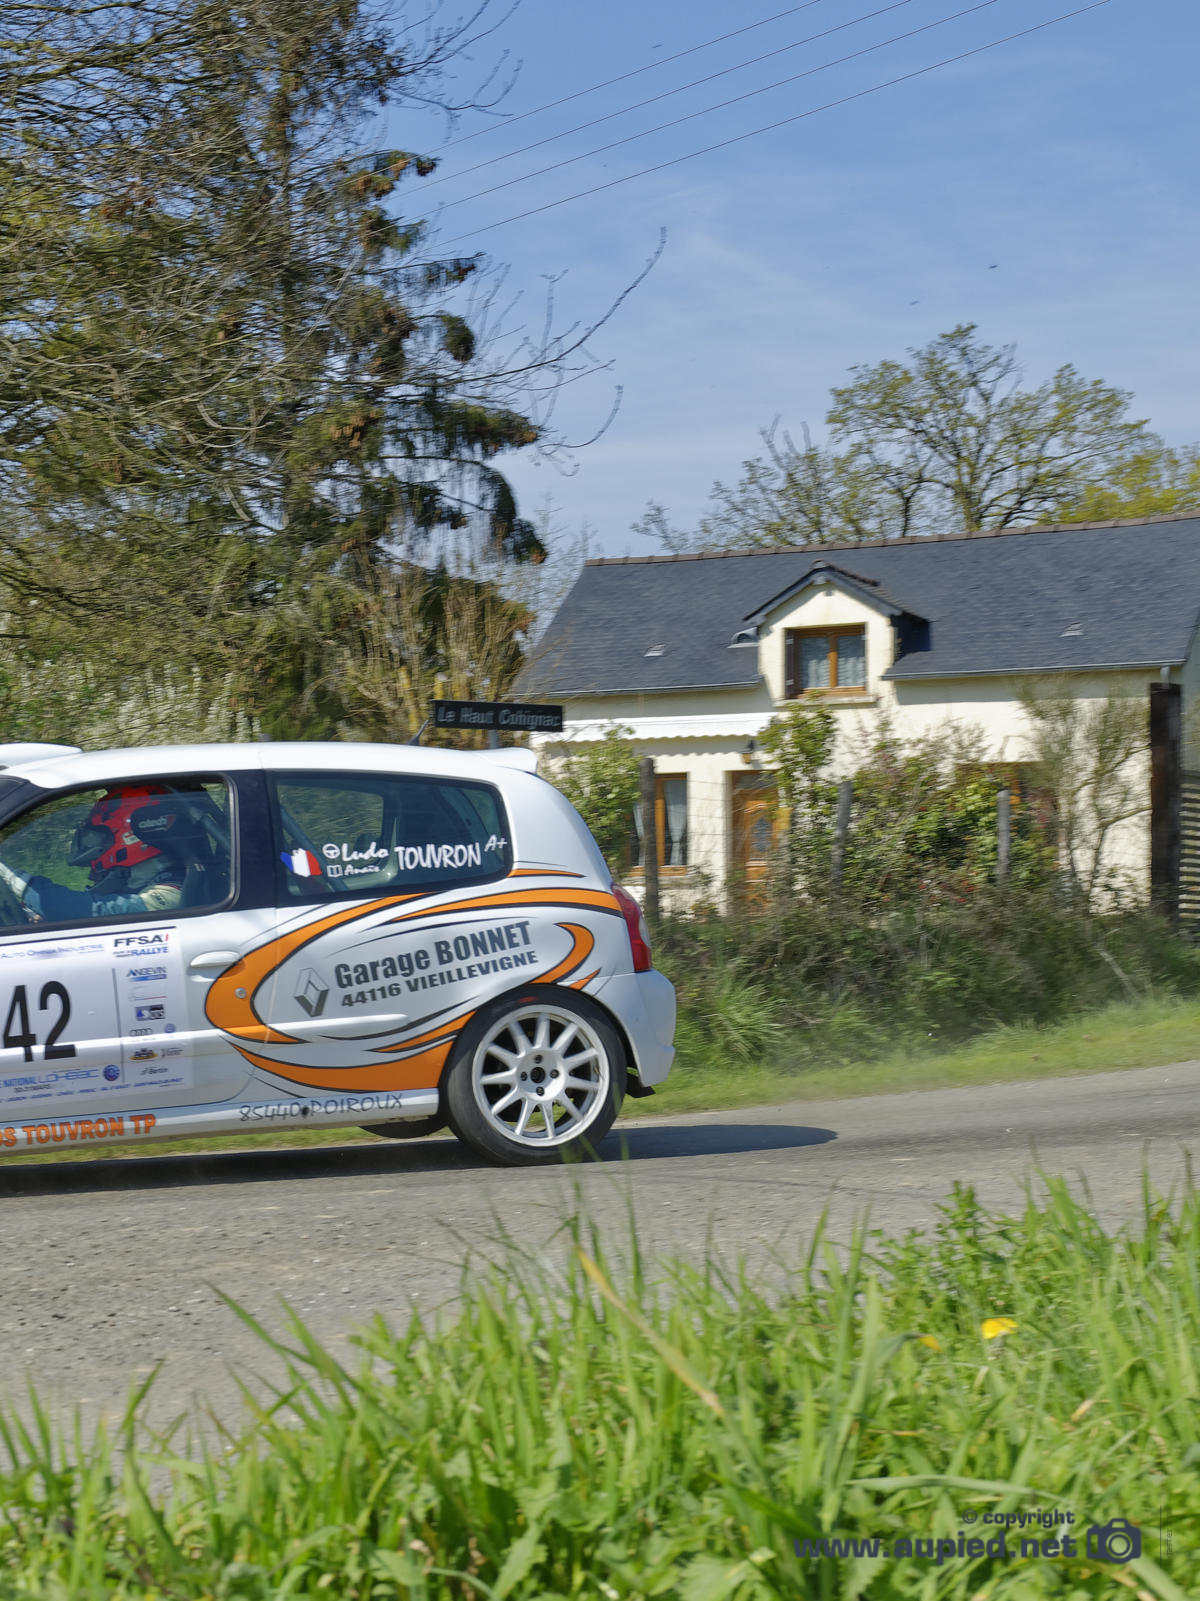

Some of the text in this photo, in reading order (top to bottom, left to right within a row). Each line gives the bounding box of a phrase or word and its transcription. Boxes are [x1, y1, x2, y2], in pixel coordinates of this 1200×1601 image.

[437, 706, 456, 722] Le
[460, 707, 494, 724] Haut
[341, 842, 390, 862] Ludo
[394, 842, 483, 871] TOUVRON
[114, 934, 164, 948] FFSA
[334, 921, 532, 989] Garage BONNET
[341, 950, 540, 1008] 44116 VIEILLEVIGNE
[3, 980, 77, 1063] 42
[310, 1093, 403, 1117] POIROUX
[20, 1116, 125, 1146] TOUVRON
[129, 1113, 157, 1136] TP
